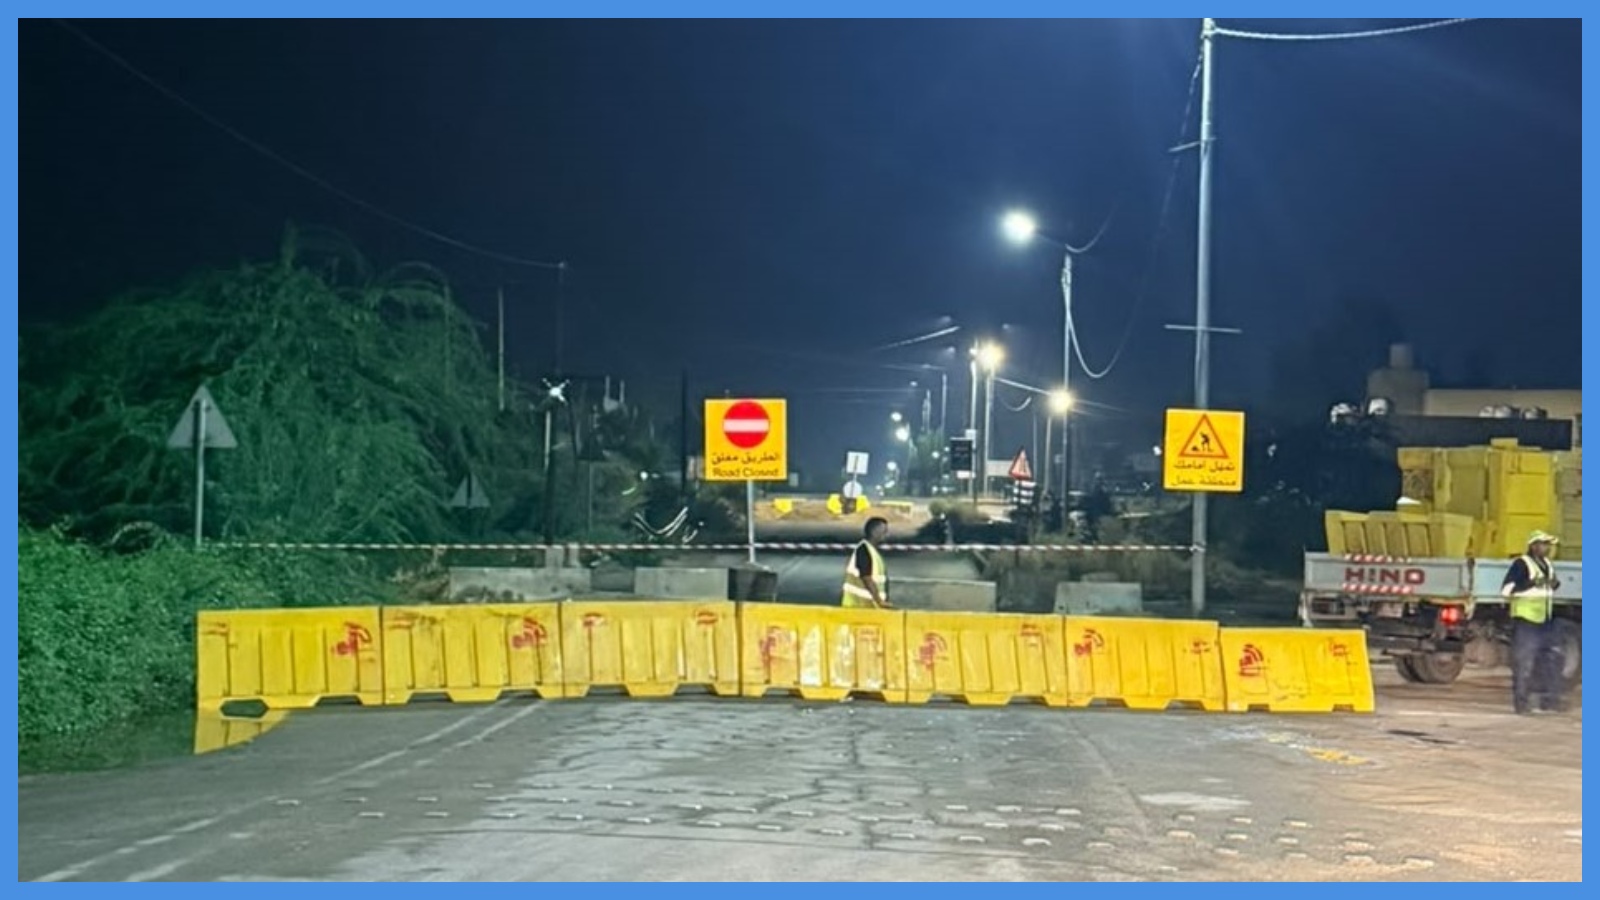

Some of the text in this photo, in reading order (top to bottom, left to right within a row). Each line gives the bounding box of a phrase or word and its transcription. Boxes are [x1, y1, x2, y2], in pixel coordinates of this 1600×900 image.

[711, 452, 780, 465] الطريق مغلق
[713, 467, 778, 477] Road Closed
[1345, 567, 1425, 585] HINO
